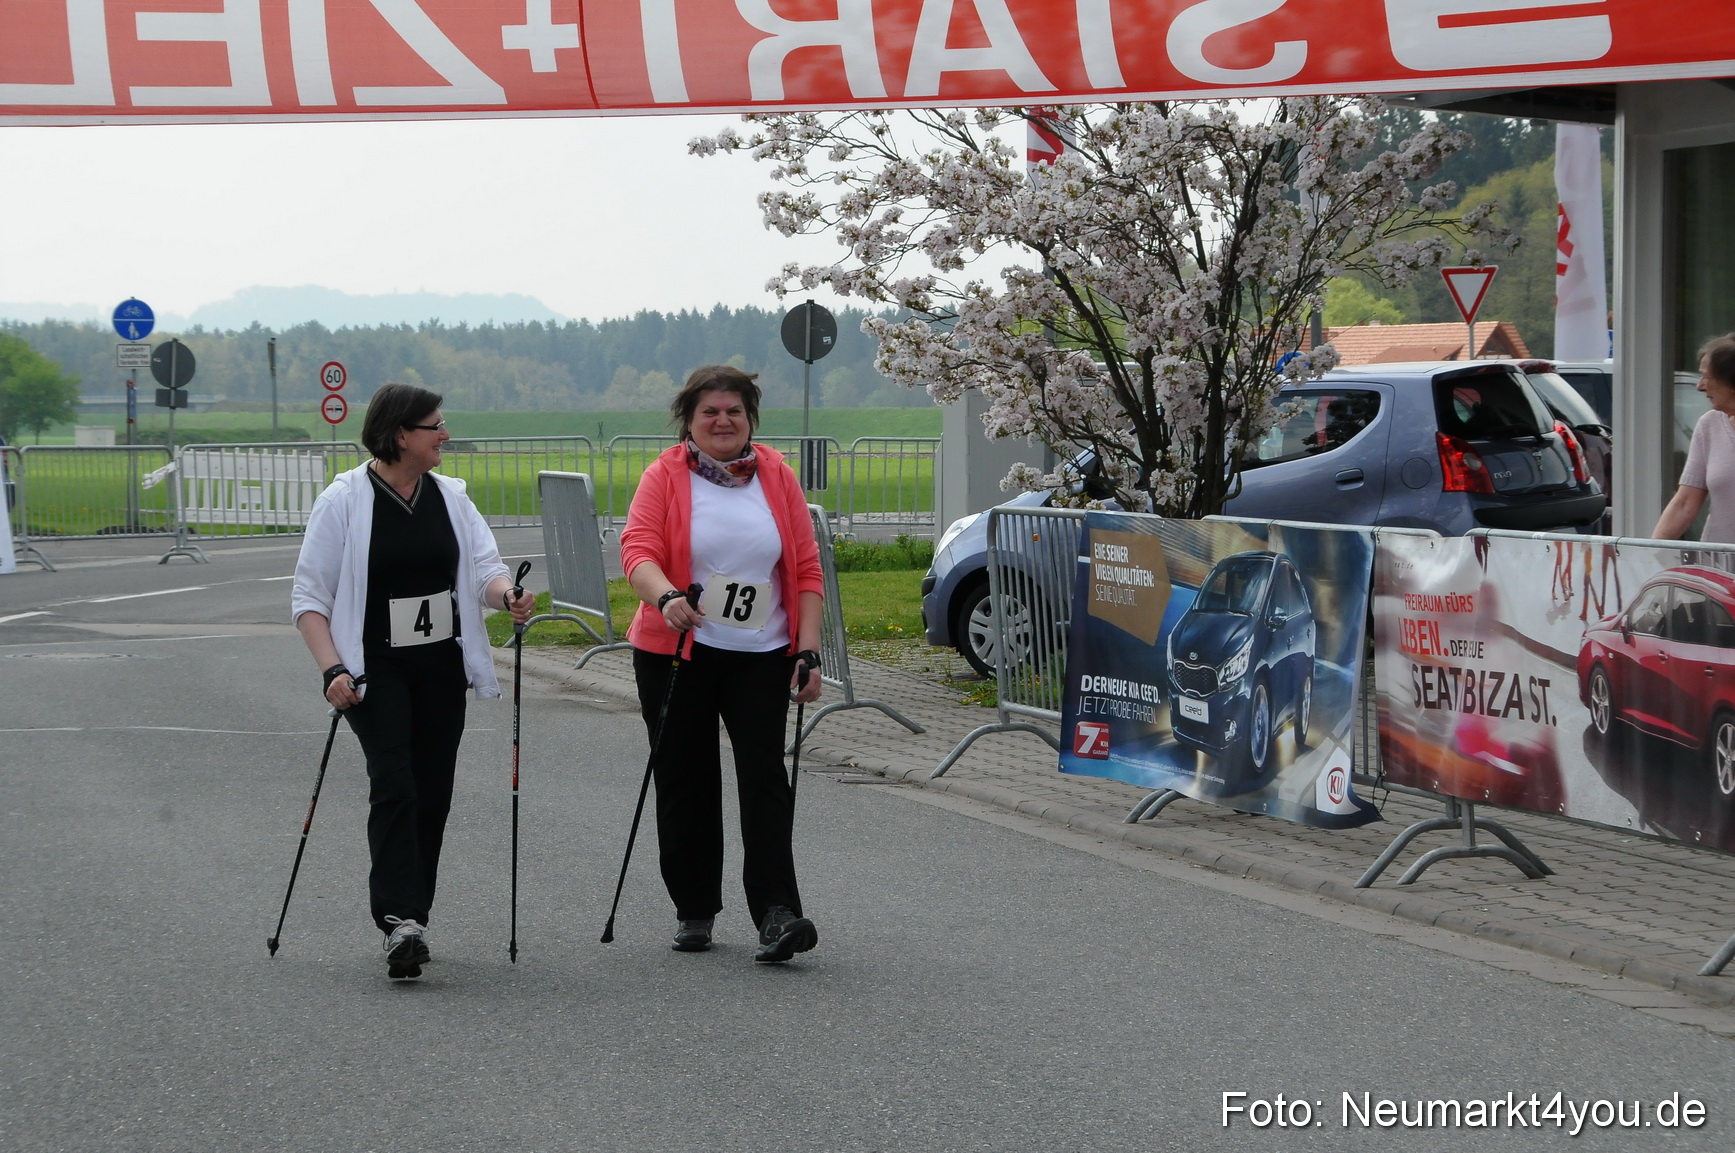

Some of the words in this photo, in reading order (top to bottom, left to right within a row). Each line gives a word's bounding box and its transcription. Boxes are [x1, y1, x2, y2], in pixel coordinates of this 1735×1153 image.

[326, 369, 341, 384] 60
[1106, 544, 1129, 564] SEINER
[721, 582, 757, 622] 13
[1404, 593, 1444, 613] FREIRAUM
[1445, 591, 1474, 613] FÜRS
[414, 598, 433, 638] 4
[1080, 674, 1107, 694] DER
[1107, 677, 1128, 698] NEUE
[1128, 680, 1140, 700] KIA
[1411, 663, 1462, 712] SEAT
[1076, 694, 1110, 717] JETZT
[1110, 698, 1132, 720] PROBE
[1078, 725, 1101, 754] 7
